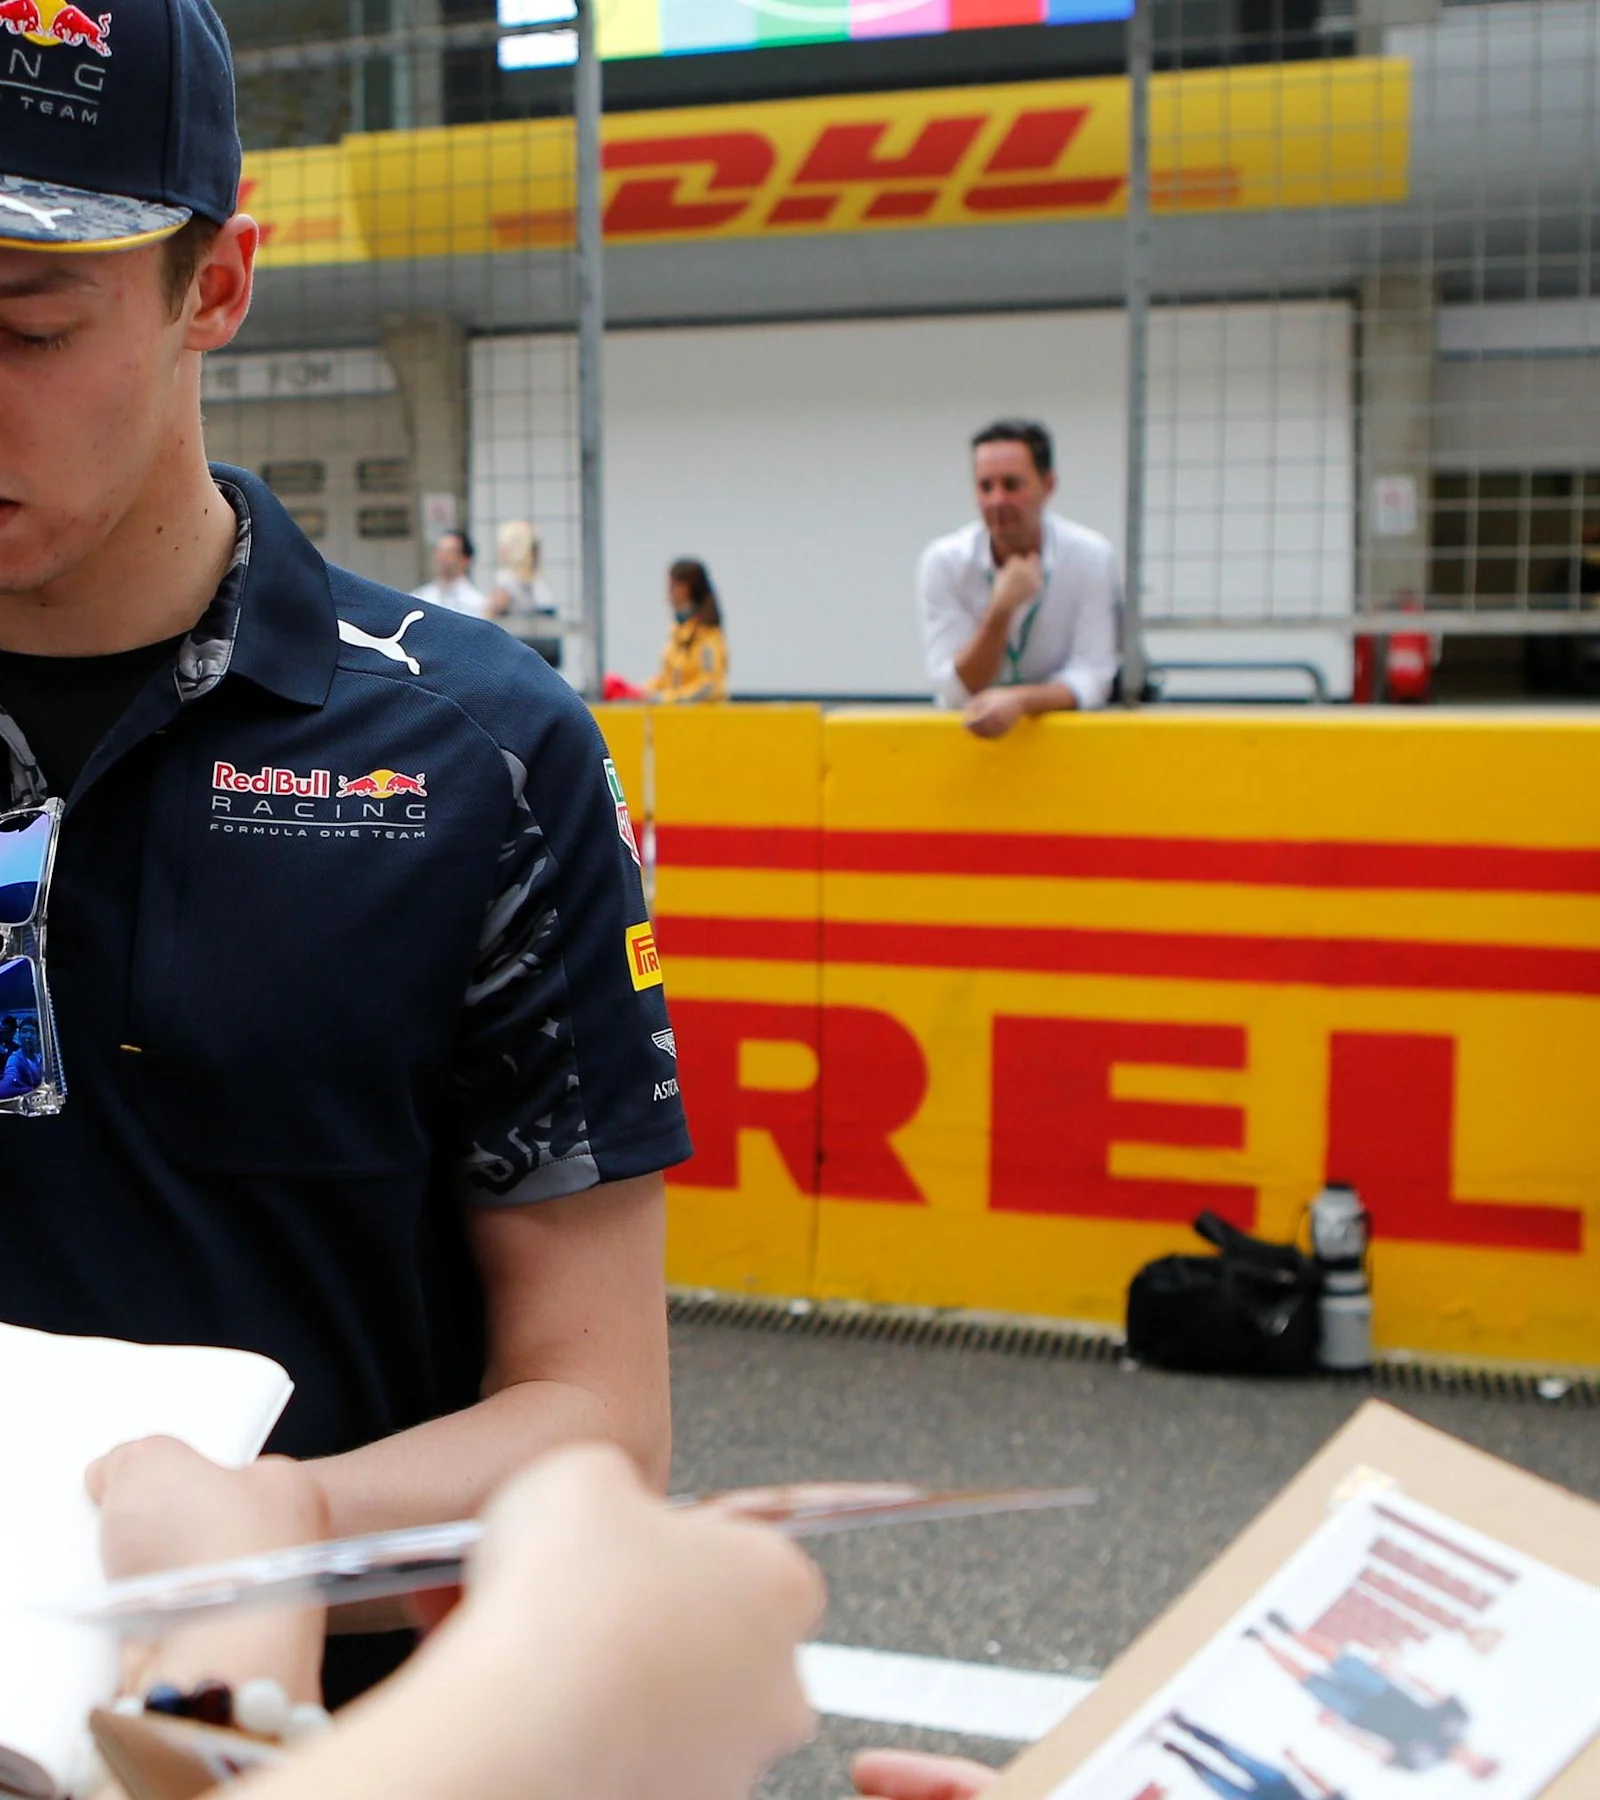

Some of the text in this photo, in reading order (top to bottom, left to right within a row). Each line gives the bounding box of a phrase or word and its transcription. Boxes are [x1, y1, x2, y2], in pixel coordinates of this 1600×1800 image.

[20, 95, 98, 126] TEAM
[600, 105, 1126, 236] DHL
[213, 762, 330, 798] Red Bull
[211, 795, 426, 820] RACING
[209, 823, 426, 841] FORMULA ONE TEAM
